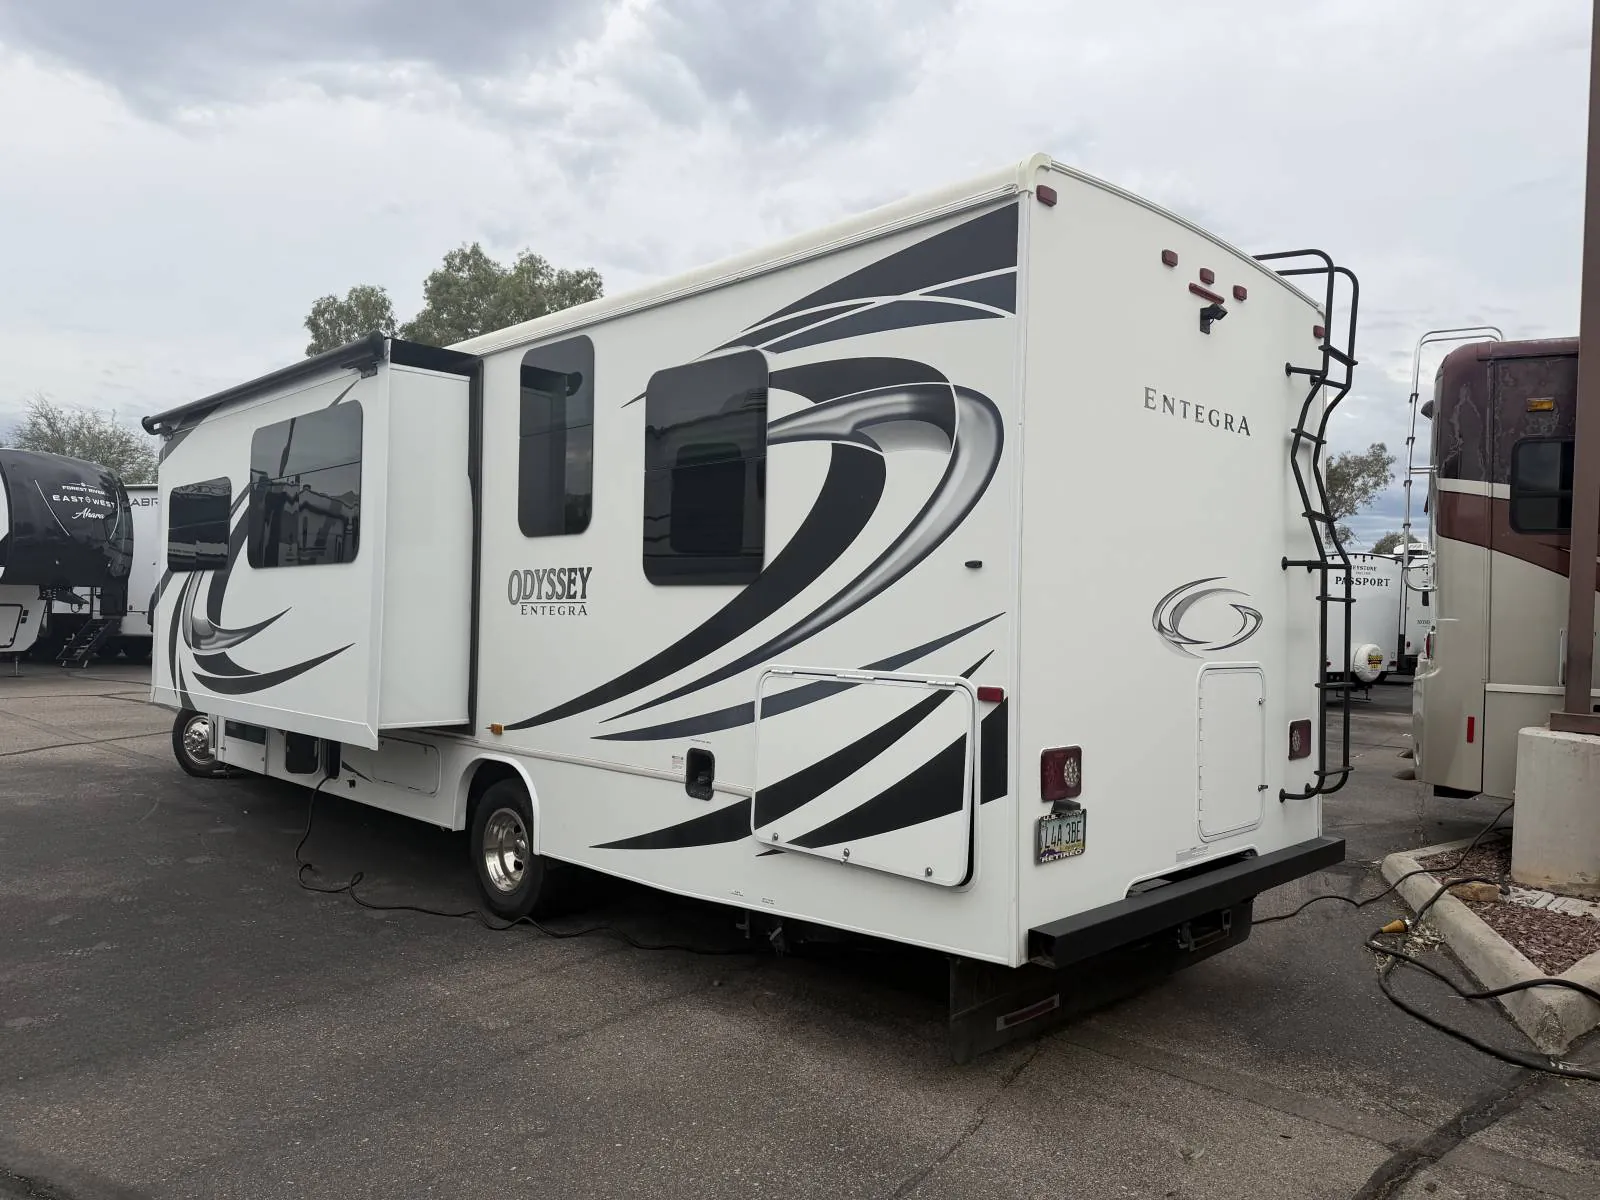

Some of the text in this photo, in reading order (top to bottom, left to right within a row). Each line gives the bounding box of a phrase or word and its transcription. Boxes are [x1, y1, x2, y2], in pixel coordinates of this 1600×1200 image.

[1144, 386, 1250, 436] ENTEGRA
[52, 494, 116, 509] EAST WEST
[507, 566, 592, 606] ODYSSEY
[521, 604, 588, 616] ENTEGRA
[1065, 820, 1082, 844] 3BE
